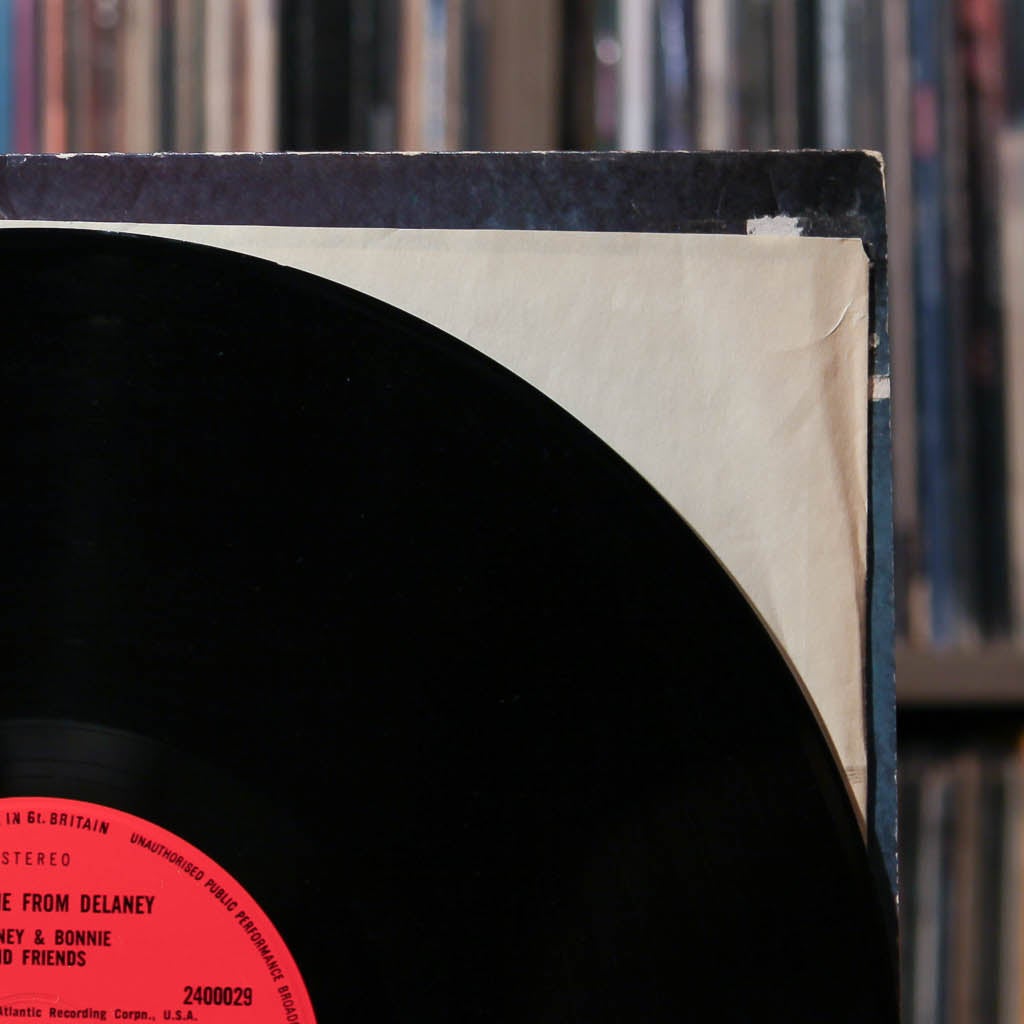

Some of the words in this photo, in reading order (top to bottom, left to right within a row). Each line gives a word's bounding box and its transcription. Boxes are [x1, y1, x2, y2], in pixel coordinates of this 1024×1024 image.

[6, 811, 20, 824] IN
[50, 812, 109, 834] BRITAIN
[2, 851, 70, 867] STEREO
[22, 893, 69, 913] FROM
[80, 895, 155, 915] DELANEY
[128, 832, 204, 882] UNAUTHORISED
[202, 878, 237, 913] PUBLIC
[233, 910, 284, 982] PERFORMANCE
[34, 929, 45, 946] &
[54, 930, 111, 947] BONNIE
[22, 950, 87, 967] FRIENDS
[184, 986, 252, 1006] 2400029
[49, 1008, 107, 1021] Recording
[163, 1010, 198, 1021] U.S.A.
